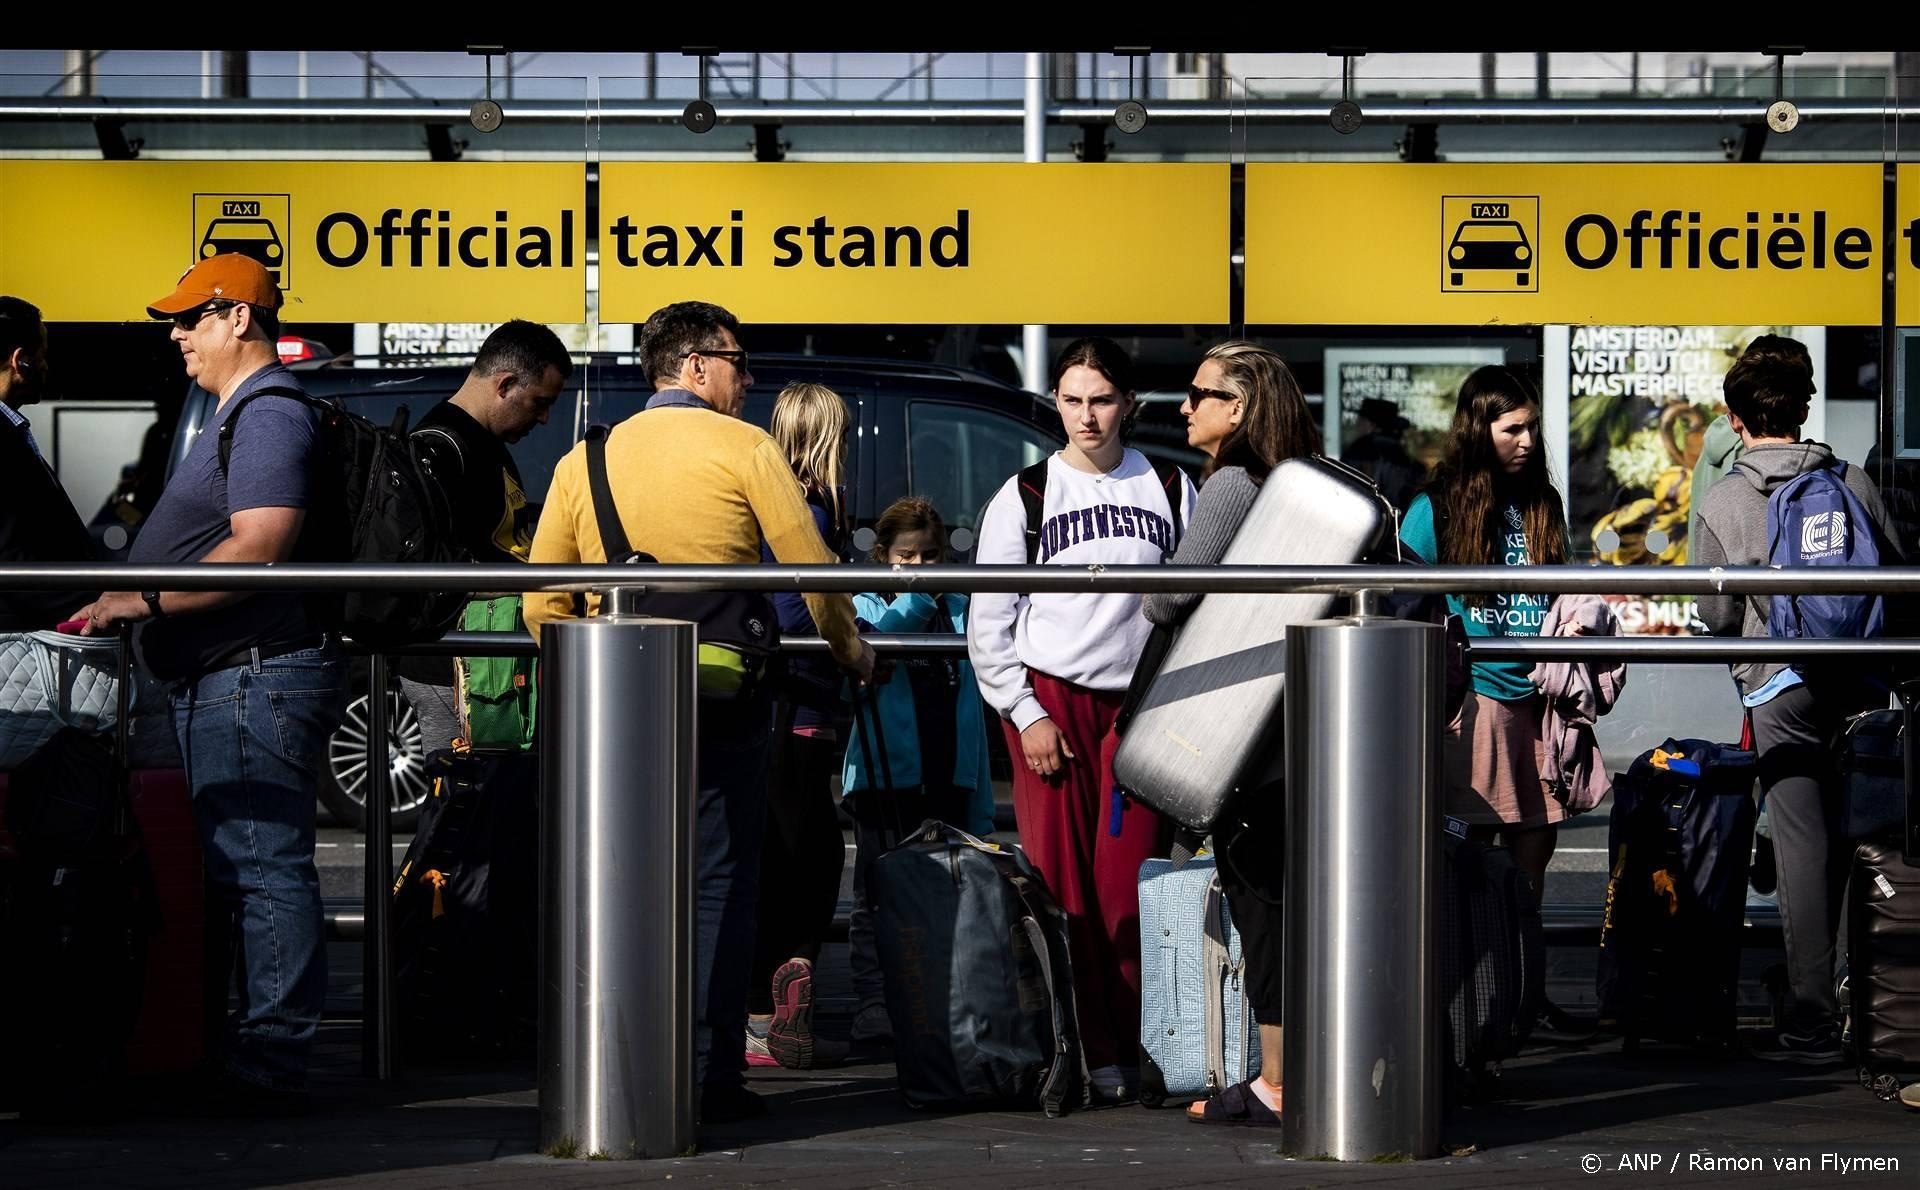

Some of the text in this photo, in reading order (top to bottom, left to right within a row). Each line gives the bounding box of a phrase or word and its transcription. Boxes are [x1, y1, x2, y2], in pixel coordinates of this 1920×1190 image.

[224, 202, 259, 216] TAXI
[1472, 205, 1508, 218] TAXI
[316, 209, 971, 268] Official taxi stand
[1564, 210, 1871, 269] Officiële
[1571, 351, 1710, 373] VISIT DUTCH
[1342, 366, 1387, 379] WHEN
[1571, 374, 1724, 396] MASTERPIECE
[1800, 548, 1844, 560] Education First
